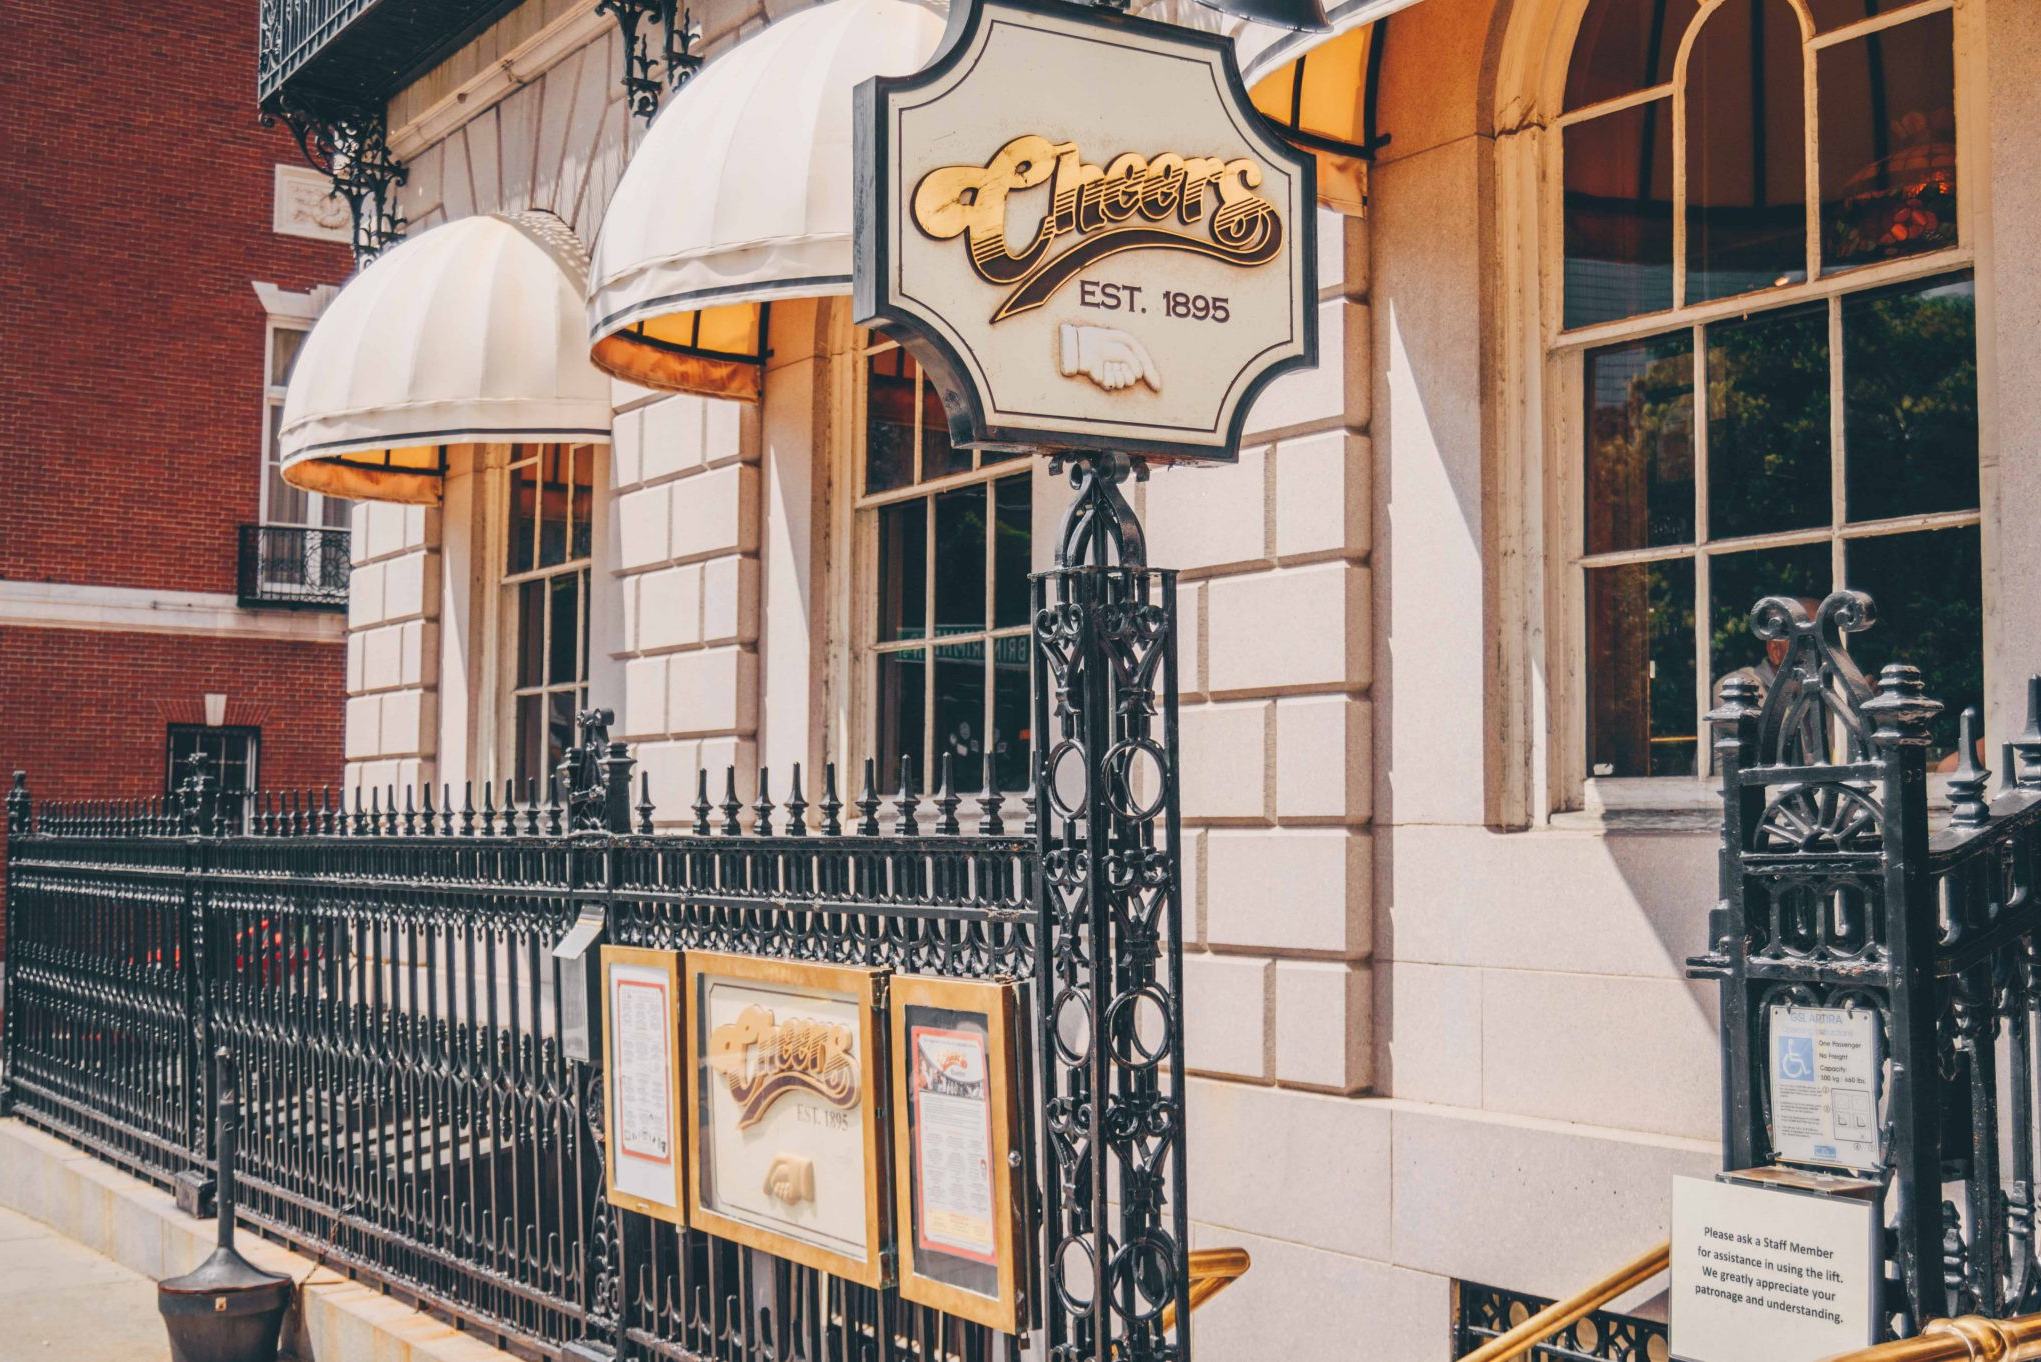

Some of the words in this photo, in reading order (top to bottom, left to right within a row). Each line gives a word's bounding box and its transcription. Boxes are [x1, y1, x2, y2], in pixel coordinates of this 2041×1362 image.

[910, 134, 1283, 325] Cheers
[1079, 279, 1147, 315] EST.
[1163, 289, 1231, 324] 1895
[710, 1003, 862, 1131] Cheers
[796, 1103, 821, 1125] EST.
[824, 1109, 849, 1132] 1895
[1705, 1227, 1734, 1241] Please
[1737, 1234, 1752, 1245] ask
[1755, 1238, 1761, 1246] a
[1764, 1237, 1787, 1250] Staff
[1790, 1242, 1833, 1259] Member
[1698, 1246, 1710, 1257] for
[1714, 1251, 1761, 1268] assistance
[1765, 1259, 1773, 1270] in
[1777, 1263, 1803, 1277] using
[1806, 1268, 1822, 1279] the
[1826, 1270, 1843, 1283] lift.
[1703, 1266, 1718, 1277] We
[1721, 1271, 1753, 1287] greatly
[1756, 1278, 1809, 1296] appreciate
[1812, 1289, 1835, 1301] your
[1695, 1285, 1743, 1303] patronage
[1746, 1295, 1763, 1306] and
[1767, 1299, 1843, 1324] understanding.
